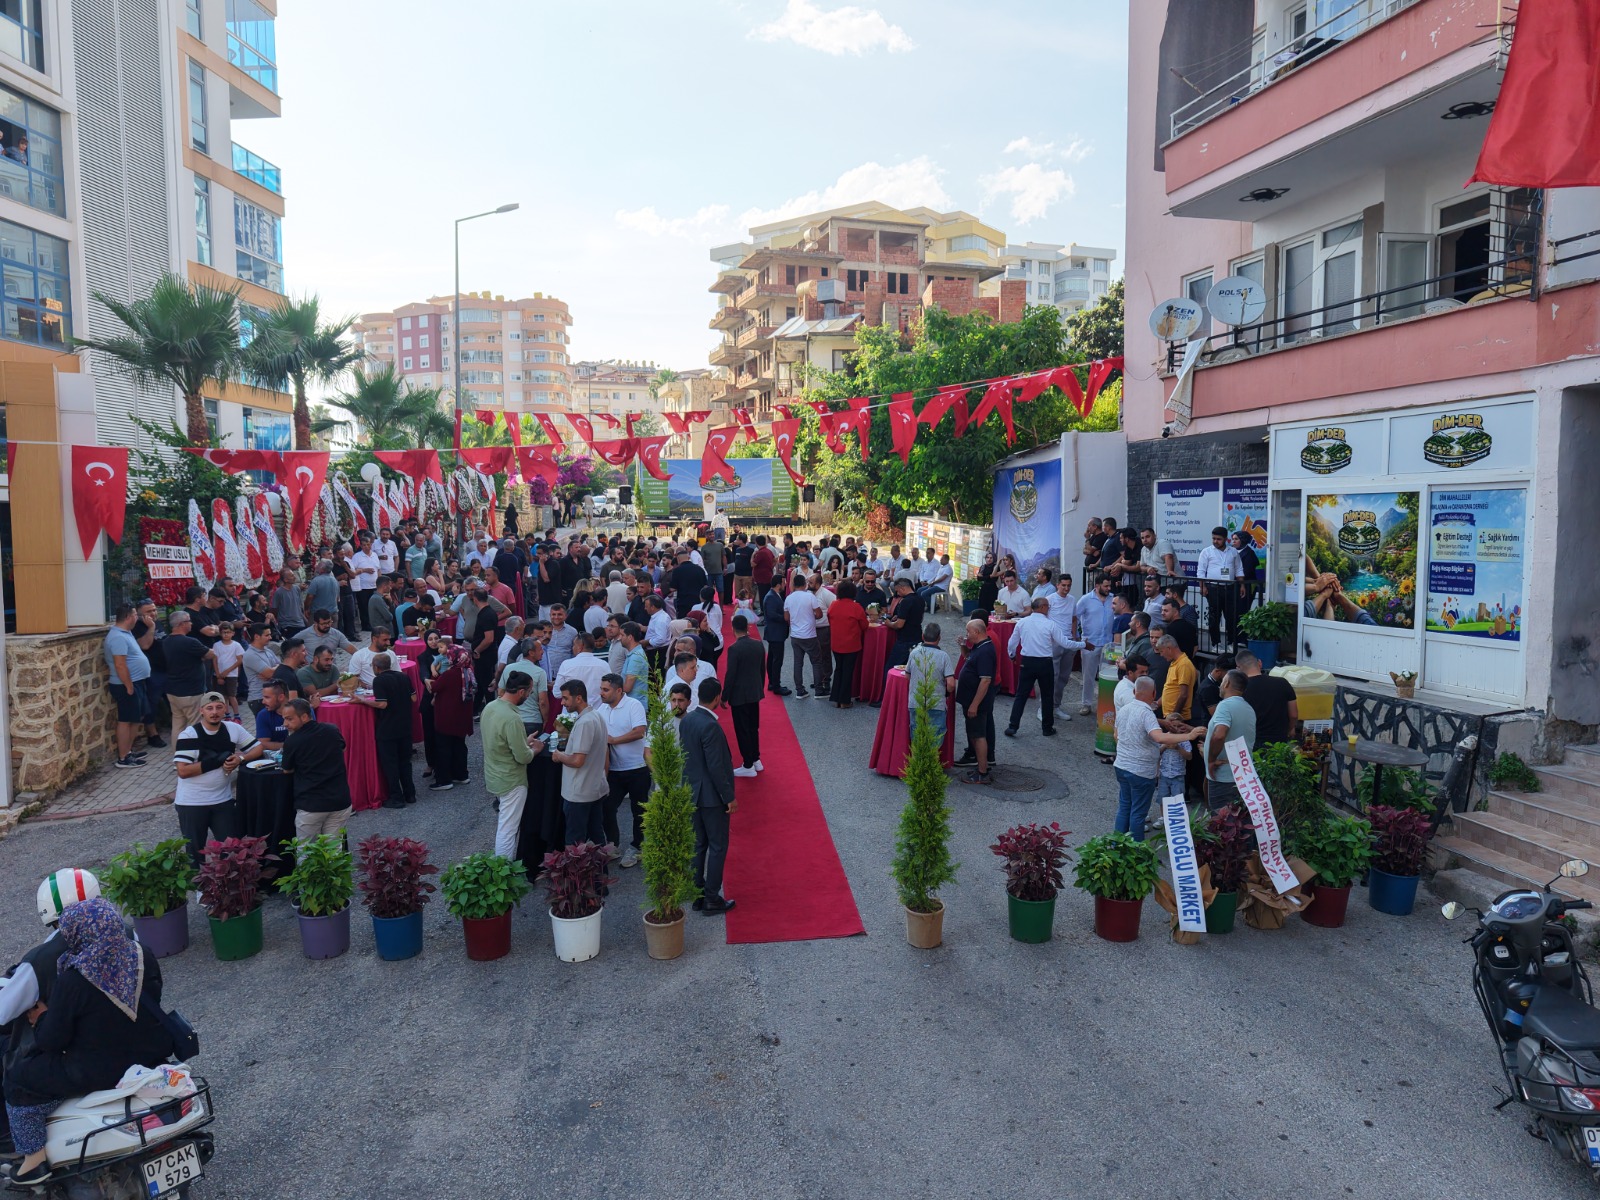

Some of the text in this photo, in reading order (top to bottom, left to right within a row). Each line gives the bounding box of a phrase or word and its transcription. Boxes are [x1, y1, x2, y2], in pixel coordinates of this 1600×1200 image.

[1219, 287, 1253, 296] POLST
[1433, 414, 1484, 433] DİM-DER
[1307, 428, 1346, 443] DİM-DER
[1442, 532, 1473, 542] Eğitim Desteği
[1487, 533, 1520, 542] Sağlık Yardımı
[151, 565, 177, 577] AYMER
[1230, 762, 1278, 879] AHMET BOZ
[1238, 749, 1292, 882] BOZ TROPİKAL ALANYA
[1167, 801, 1202, 925] İMAMOĞLU MARKET
[146, 1145, 195, 1177] 07 CAK
[165, 1165, 191, 1187] 579
